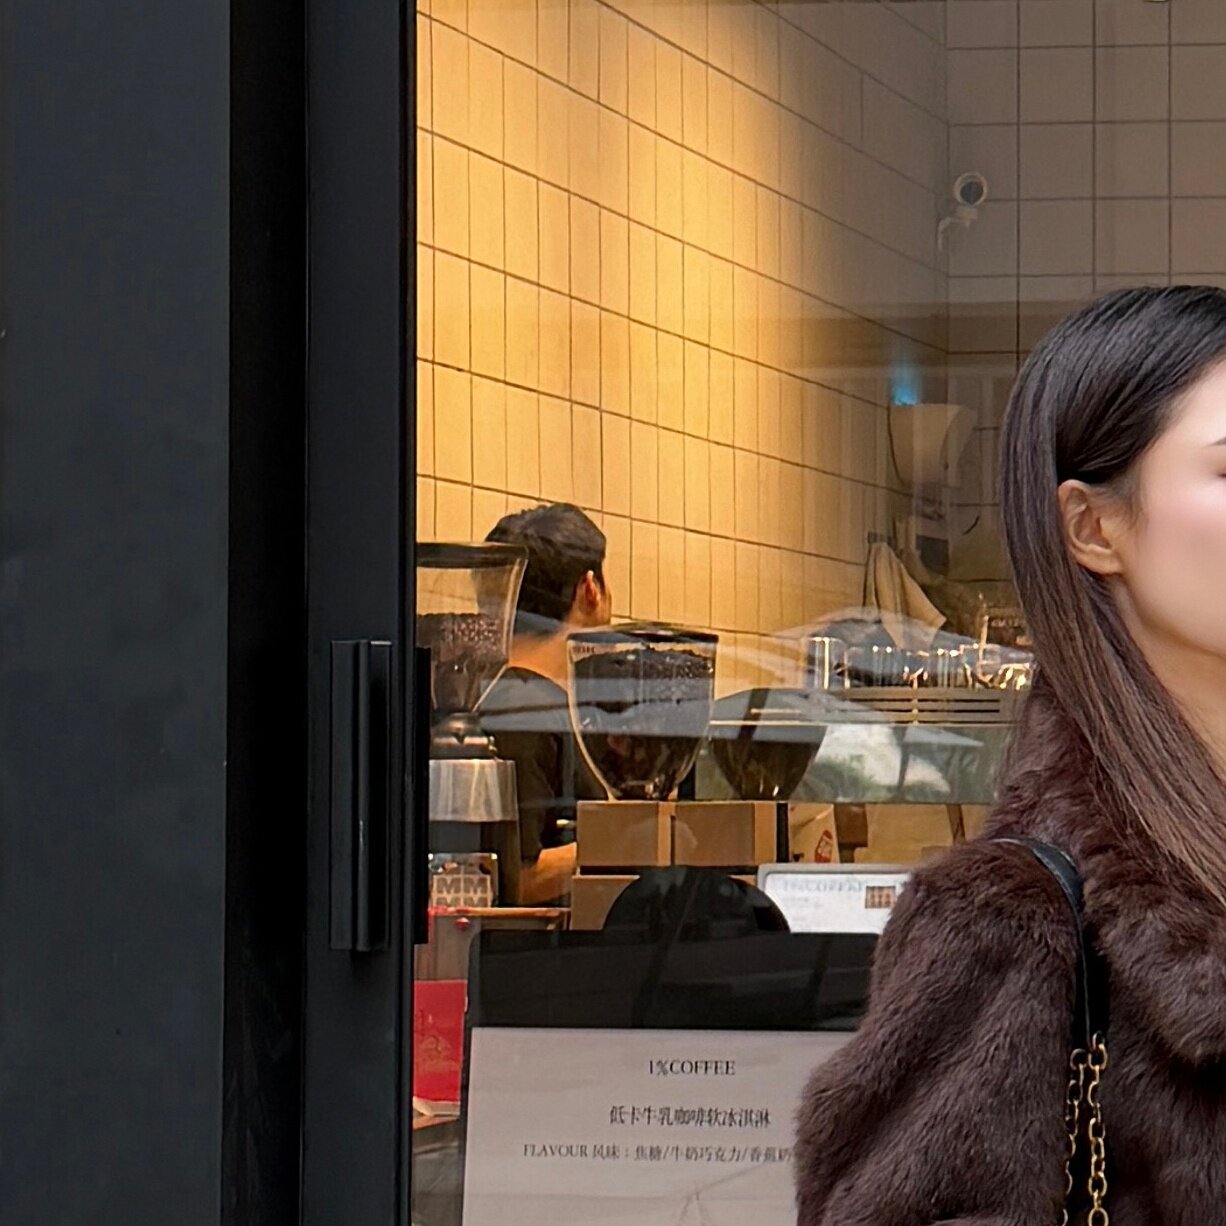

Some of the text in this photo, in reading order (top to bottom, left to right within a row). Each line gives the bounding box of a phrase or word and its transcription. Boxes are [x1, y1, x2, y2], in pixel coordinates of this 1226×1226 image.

[649, 1059, 736, 1076] 1%COFFEE
[609, 1104, 771, 1128] 低卡牛乳咖啡软冰淇淋
[523, 1143, 588, 1158] FLAVOUR
